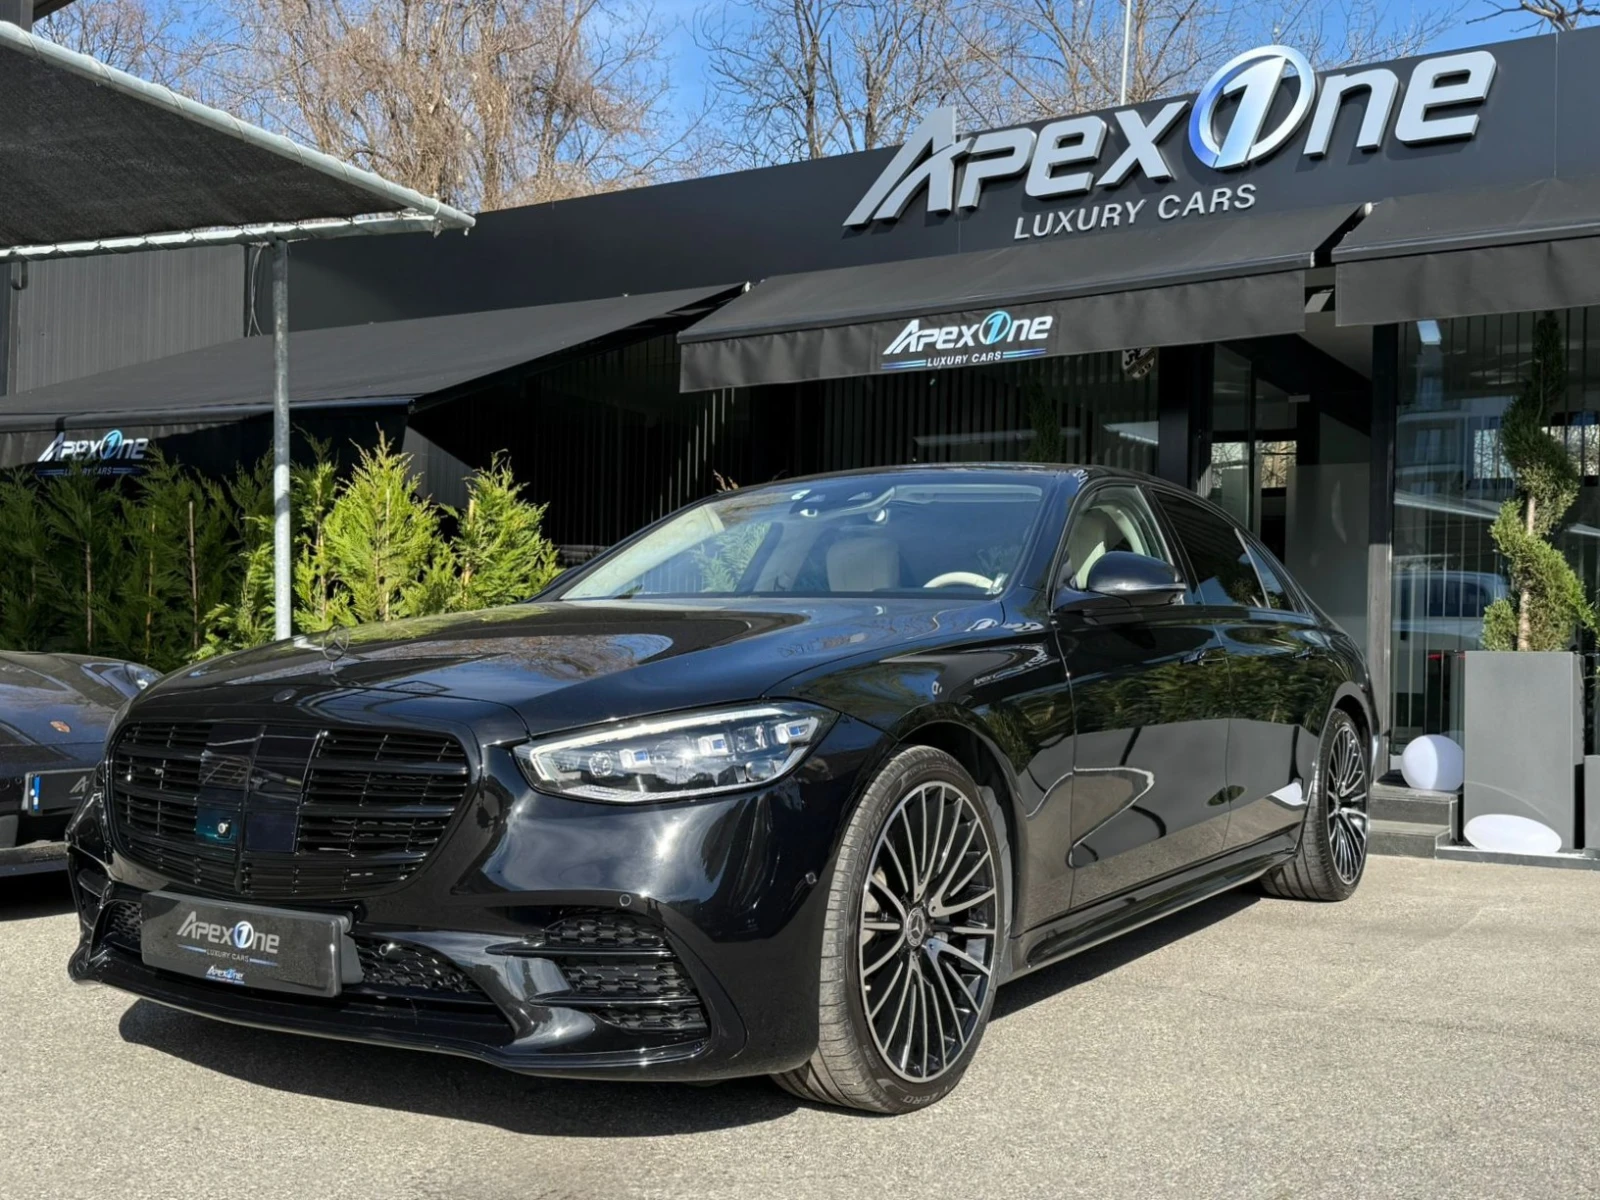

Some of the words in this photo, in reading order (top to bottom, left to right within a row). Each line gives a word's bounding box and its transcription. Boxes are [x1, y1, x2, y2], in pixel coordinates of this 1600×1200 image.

[1013, 199, 1147, 240] LUXURY
[1157, 183, 1257, 220] CARS
[927, 354, 969, 367] LUXURY
[971, 350, 1002, 363] CARS
